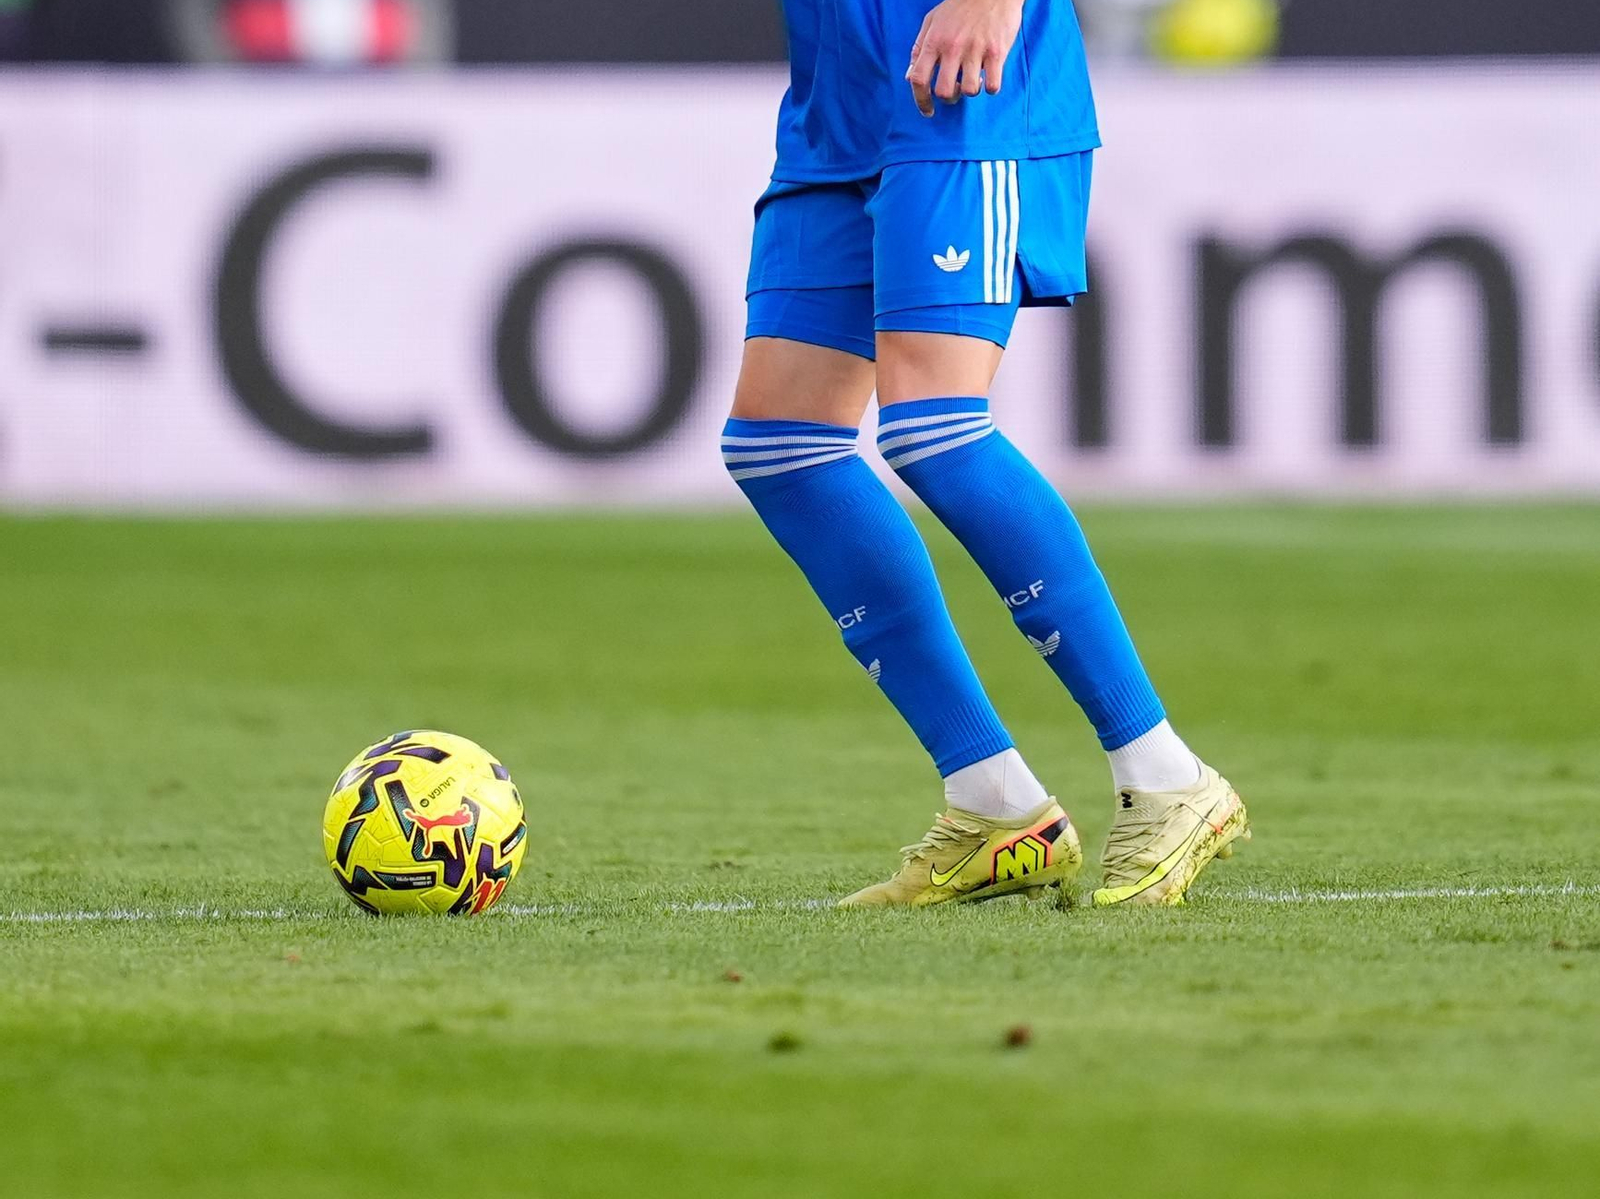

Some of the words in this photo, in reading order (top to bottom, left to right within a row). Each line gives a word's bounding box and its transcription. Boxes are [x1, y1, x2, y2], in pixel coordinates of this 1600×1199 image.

[1003, 579, 1044, 608] CF
[834, 605, 866, 631] CF
[427, 776, 456, 800] LALIGA
